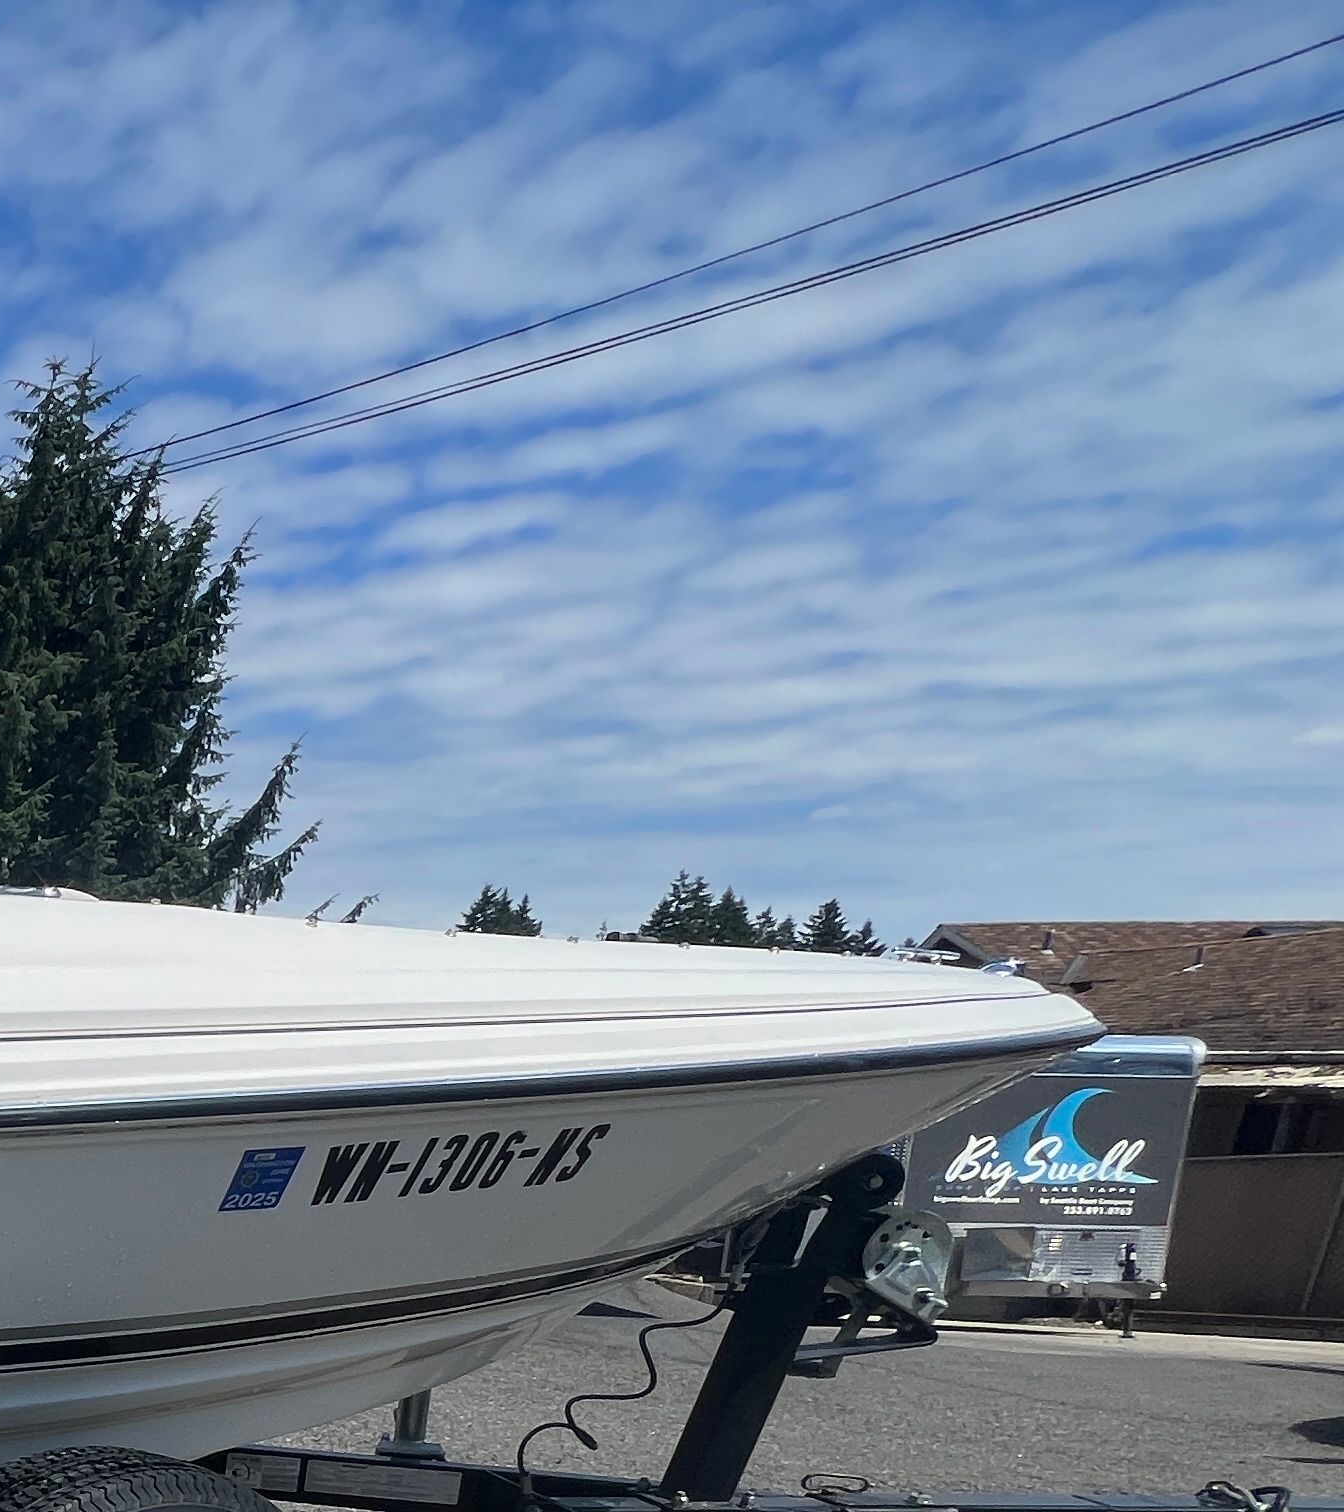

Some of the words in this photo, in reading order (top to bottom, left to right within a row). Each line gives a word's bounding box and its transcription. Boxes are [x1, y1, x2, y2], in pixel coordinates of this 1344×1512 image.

[944, 1134, 1018, 1198] Big
[1016, 1135, 1146, 1185] Swell
[223, 1191, 280, 1209] 2025
